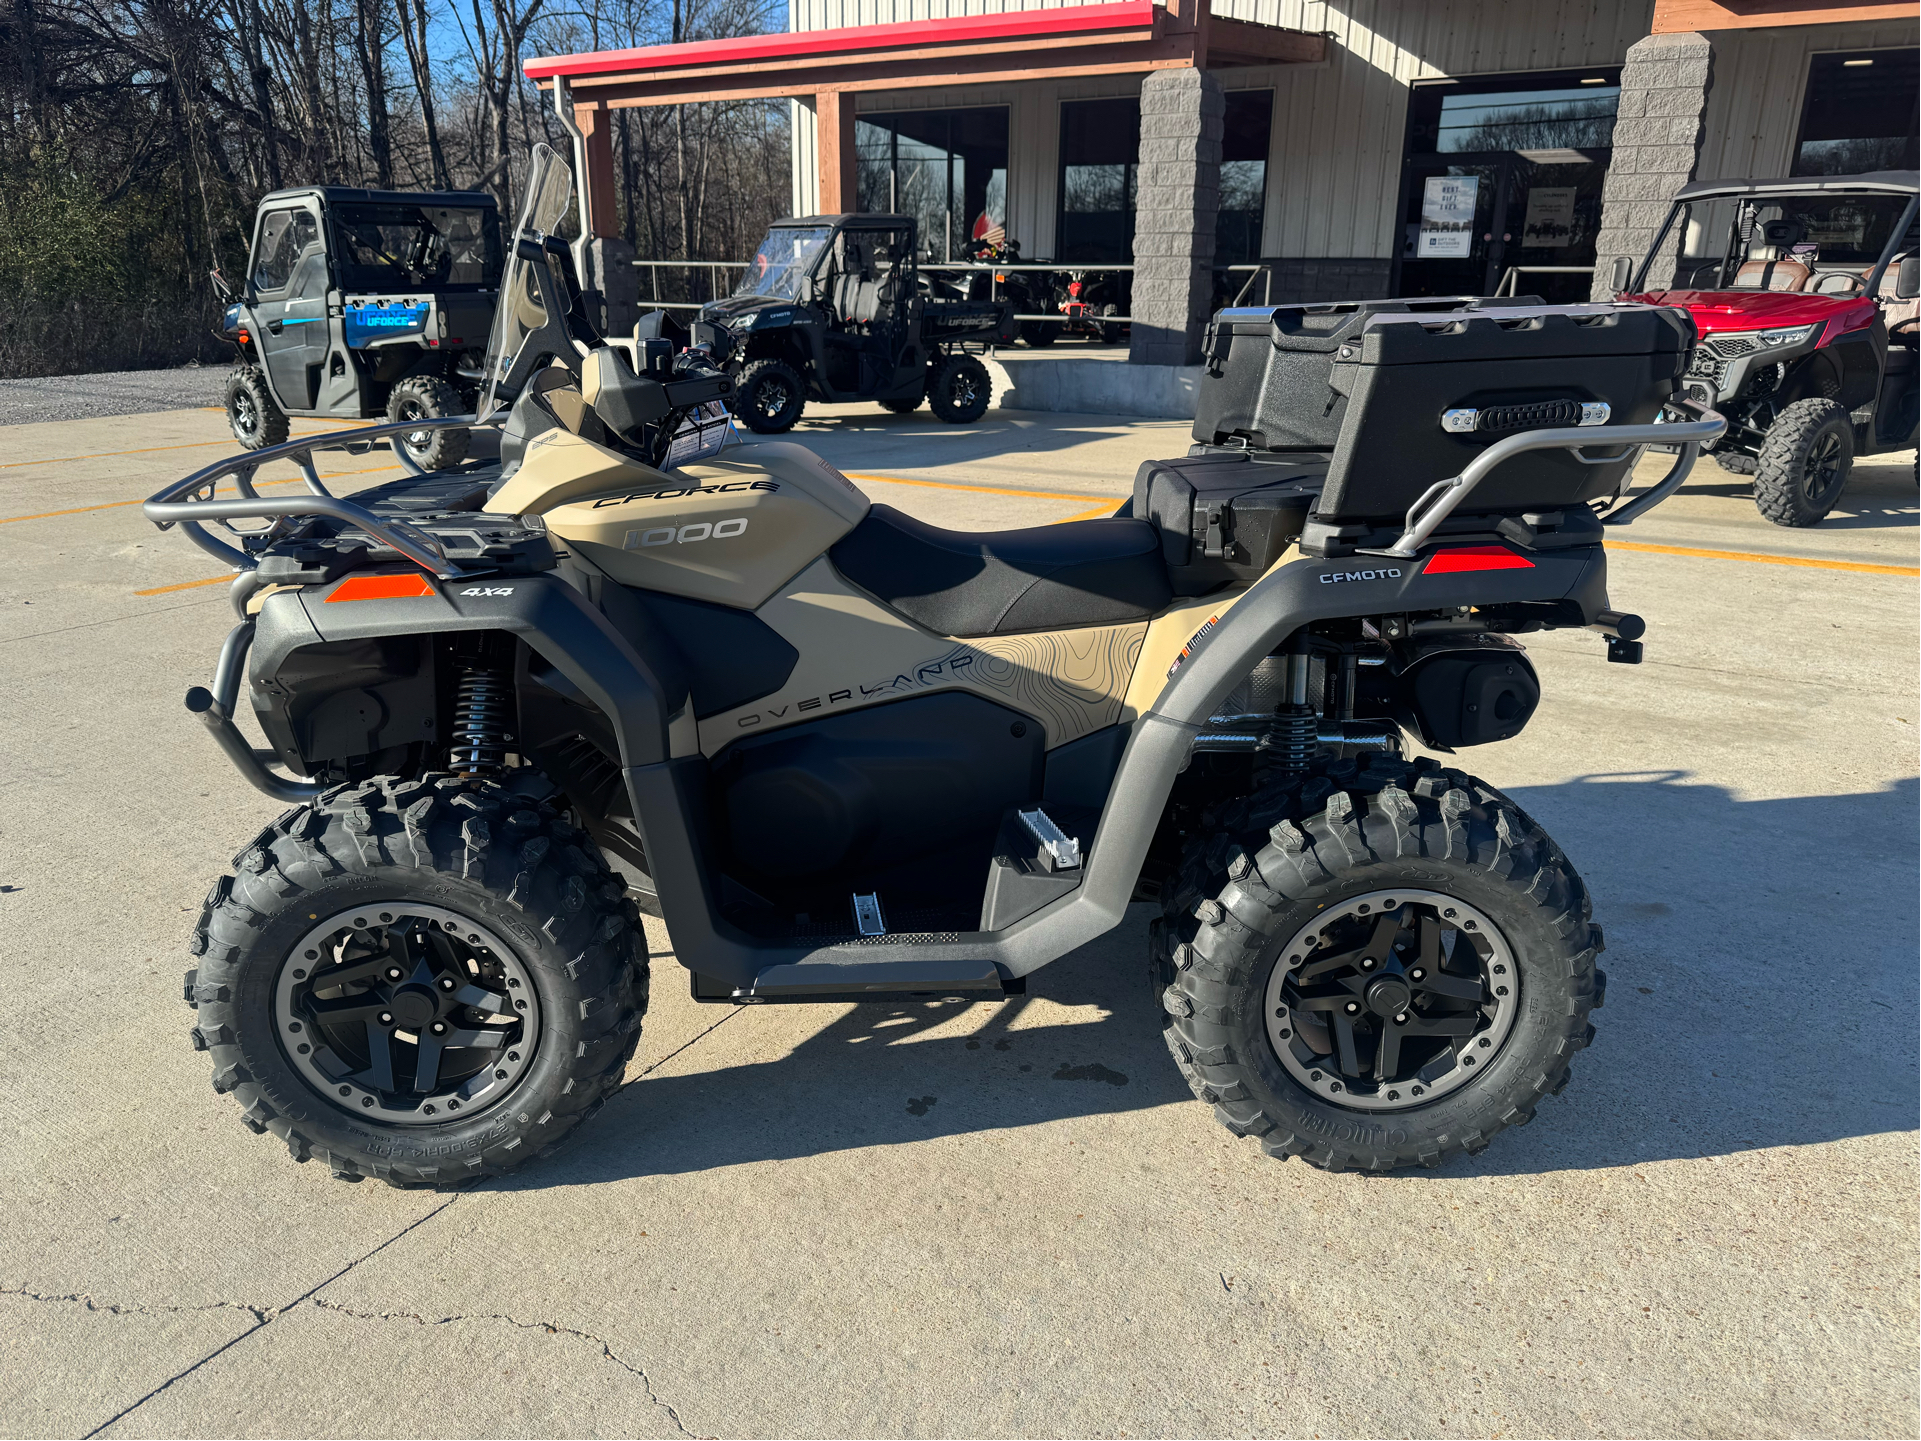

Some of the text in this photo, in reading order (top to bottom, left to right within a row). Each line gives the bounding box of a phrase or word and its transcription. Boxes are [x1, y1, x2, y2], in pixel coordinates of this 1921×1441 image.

[366, 316, 410, 327] UFORCE
[948, 318, 990, 327] UFORCE
[532, 431, 559, 451] EPS
[592, 480, 781, 510] CFORCE
[622, 517, 749, 550] 1000
[1319, 568, 1402, 584] CFMOTO
[737, 655, 974, 728] OVERLAND
